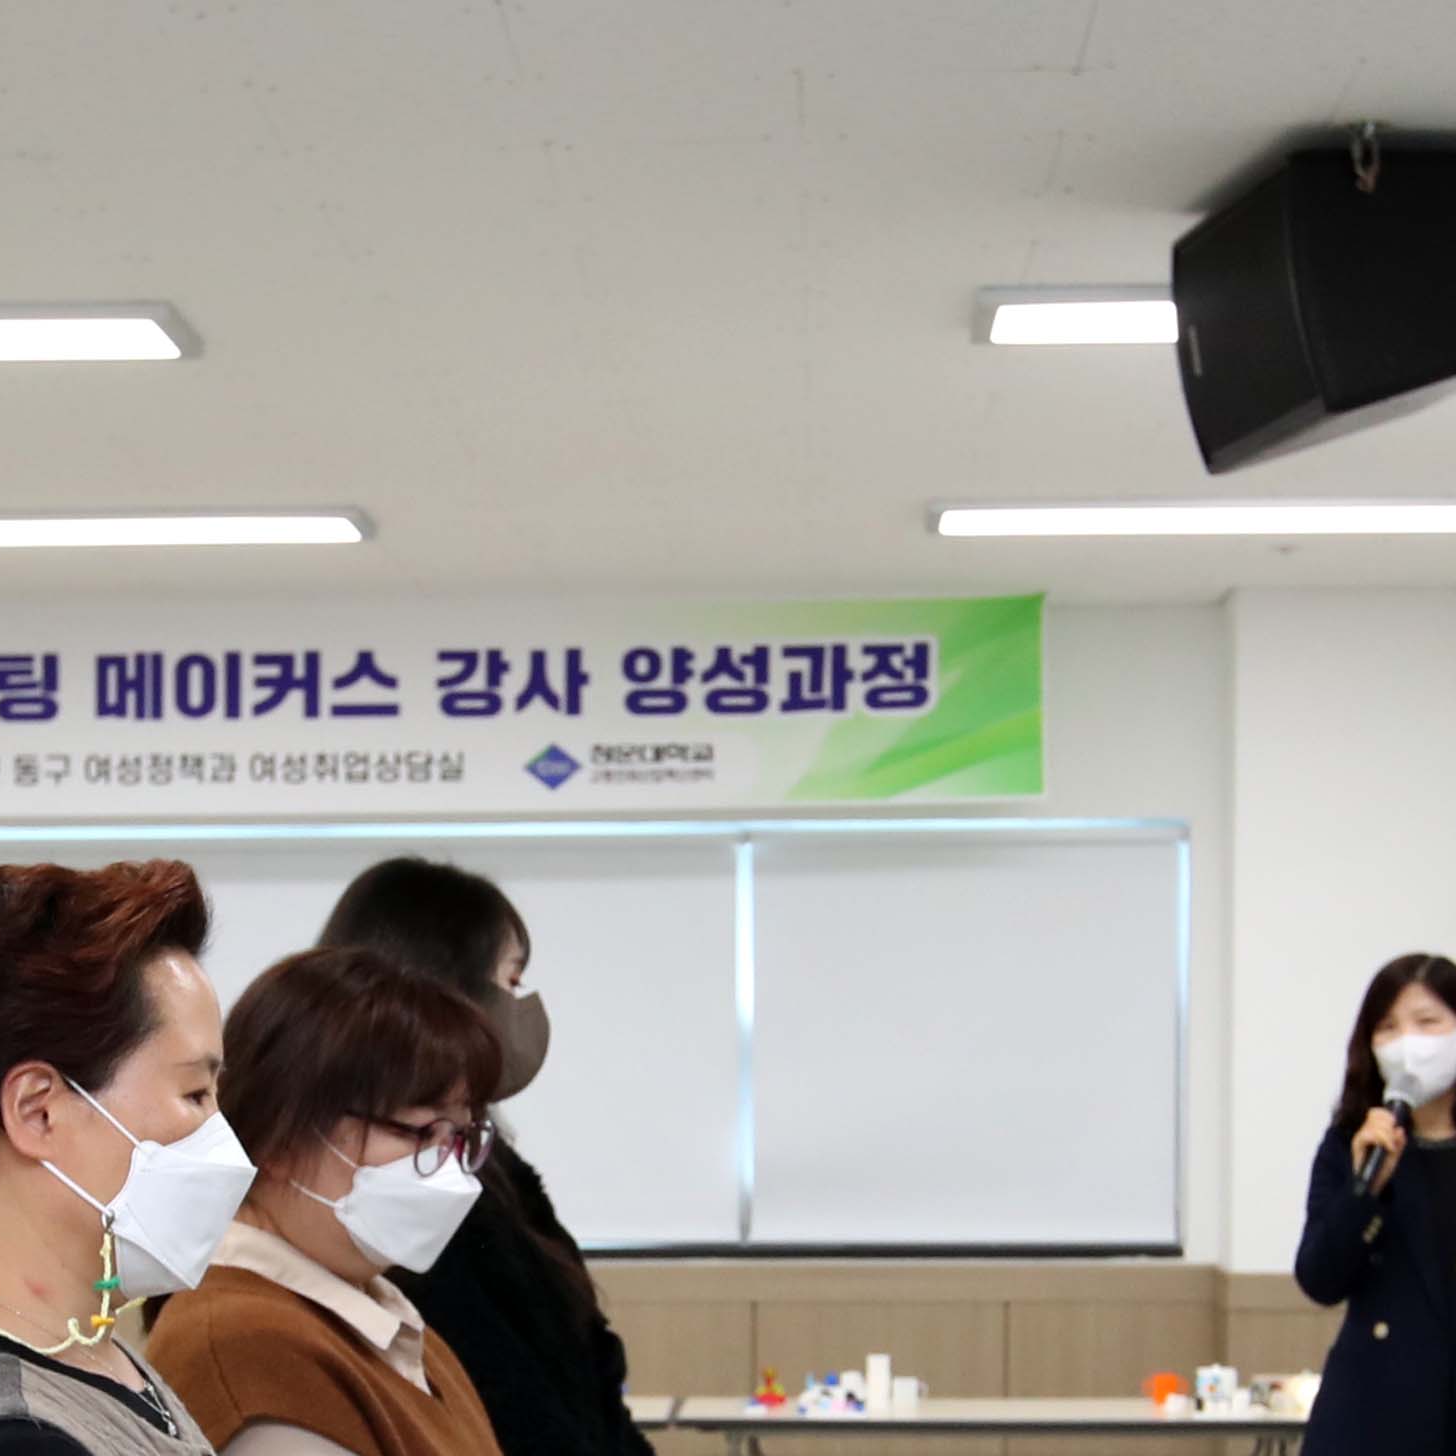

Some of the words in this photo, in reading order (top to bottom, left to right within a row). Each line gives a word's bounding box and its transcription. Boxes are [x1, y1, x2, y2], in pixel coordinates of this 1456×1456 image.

[95, 650, 400, 720] 메이커스
[436, 647, 590, 718] 강사
[621, 641, 931, 715] 양성과정
[13, 754, 71, 784] 동구
[84, 753, 237, 784] 여성정책과
[249, 750, 465, 783] 여성취업상담실
